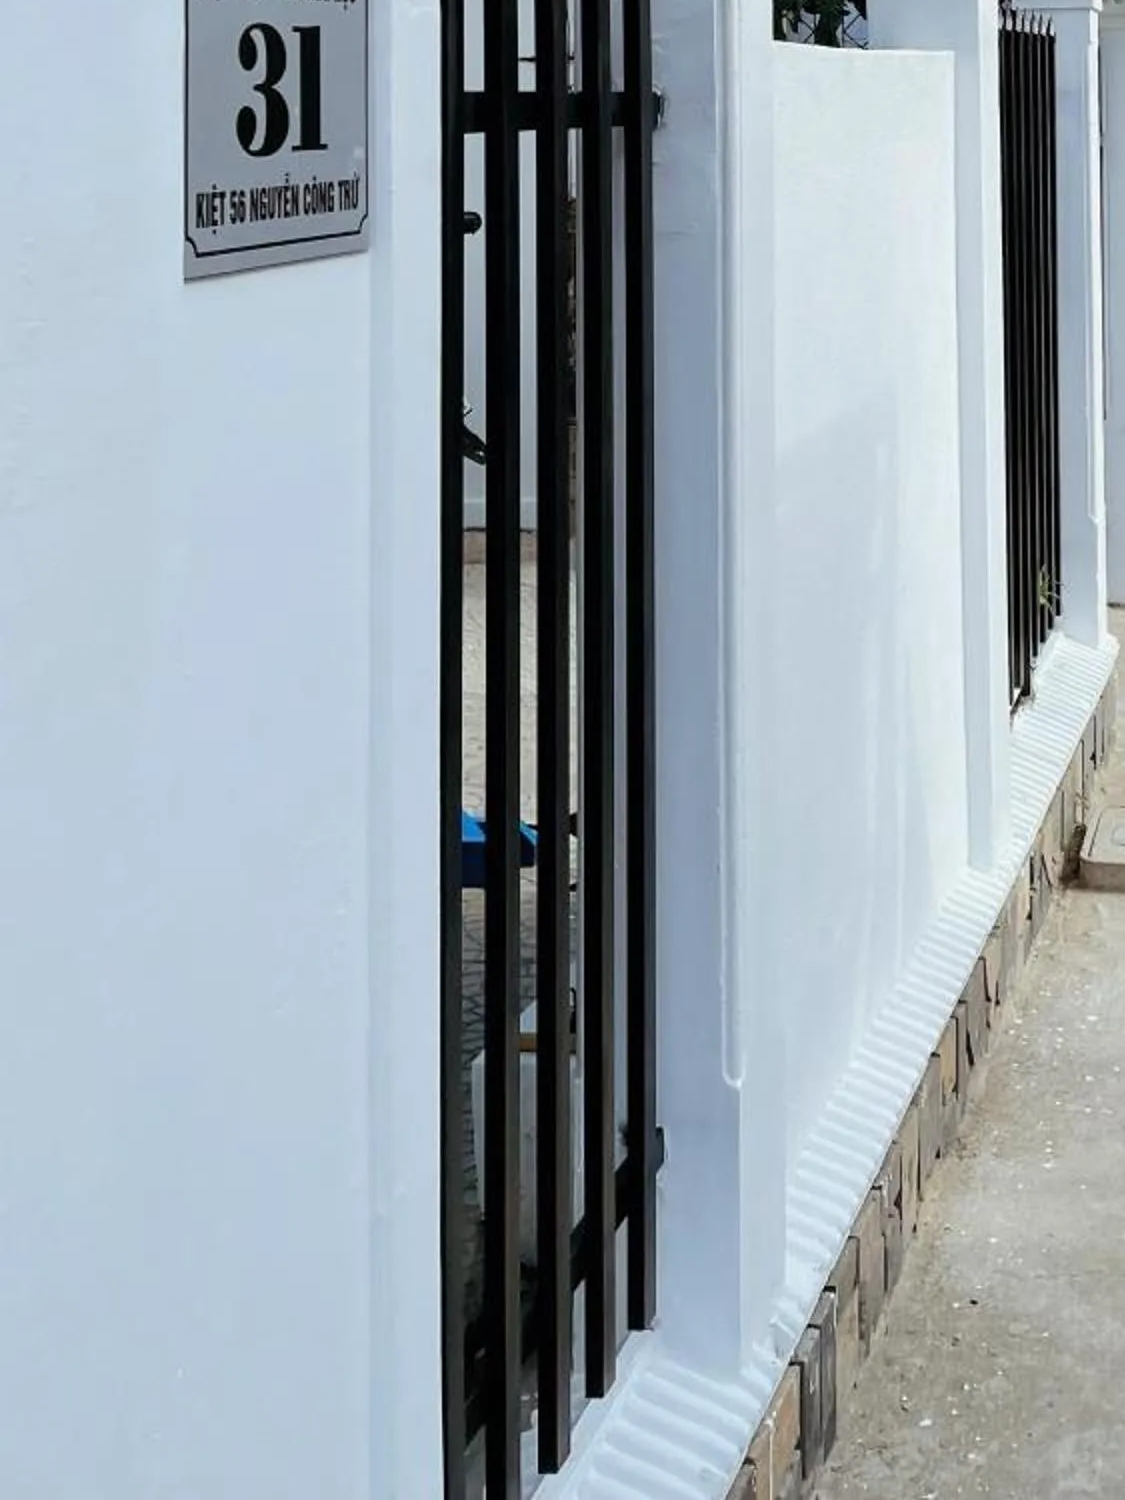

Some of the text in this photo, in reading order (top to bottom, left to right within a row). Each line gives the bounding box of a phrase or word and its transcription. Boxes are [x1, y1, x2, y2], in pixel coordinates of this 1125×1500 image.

[236, 23, 328, 157] 31
[195, 184, 226, 235] KIỆT
[229, 190, 246, 224] 56
